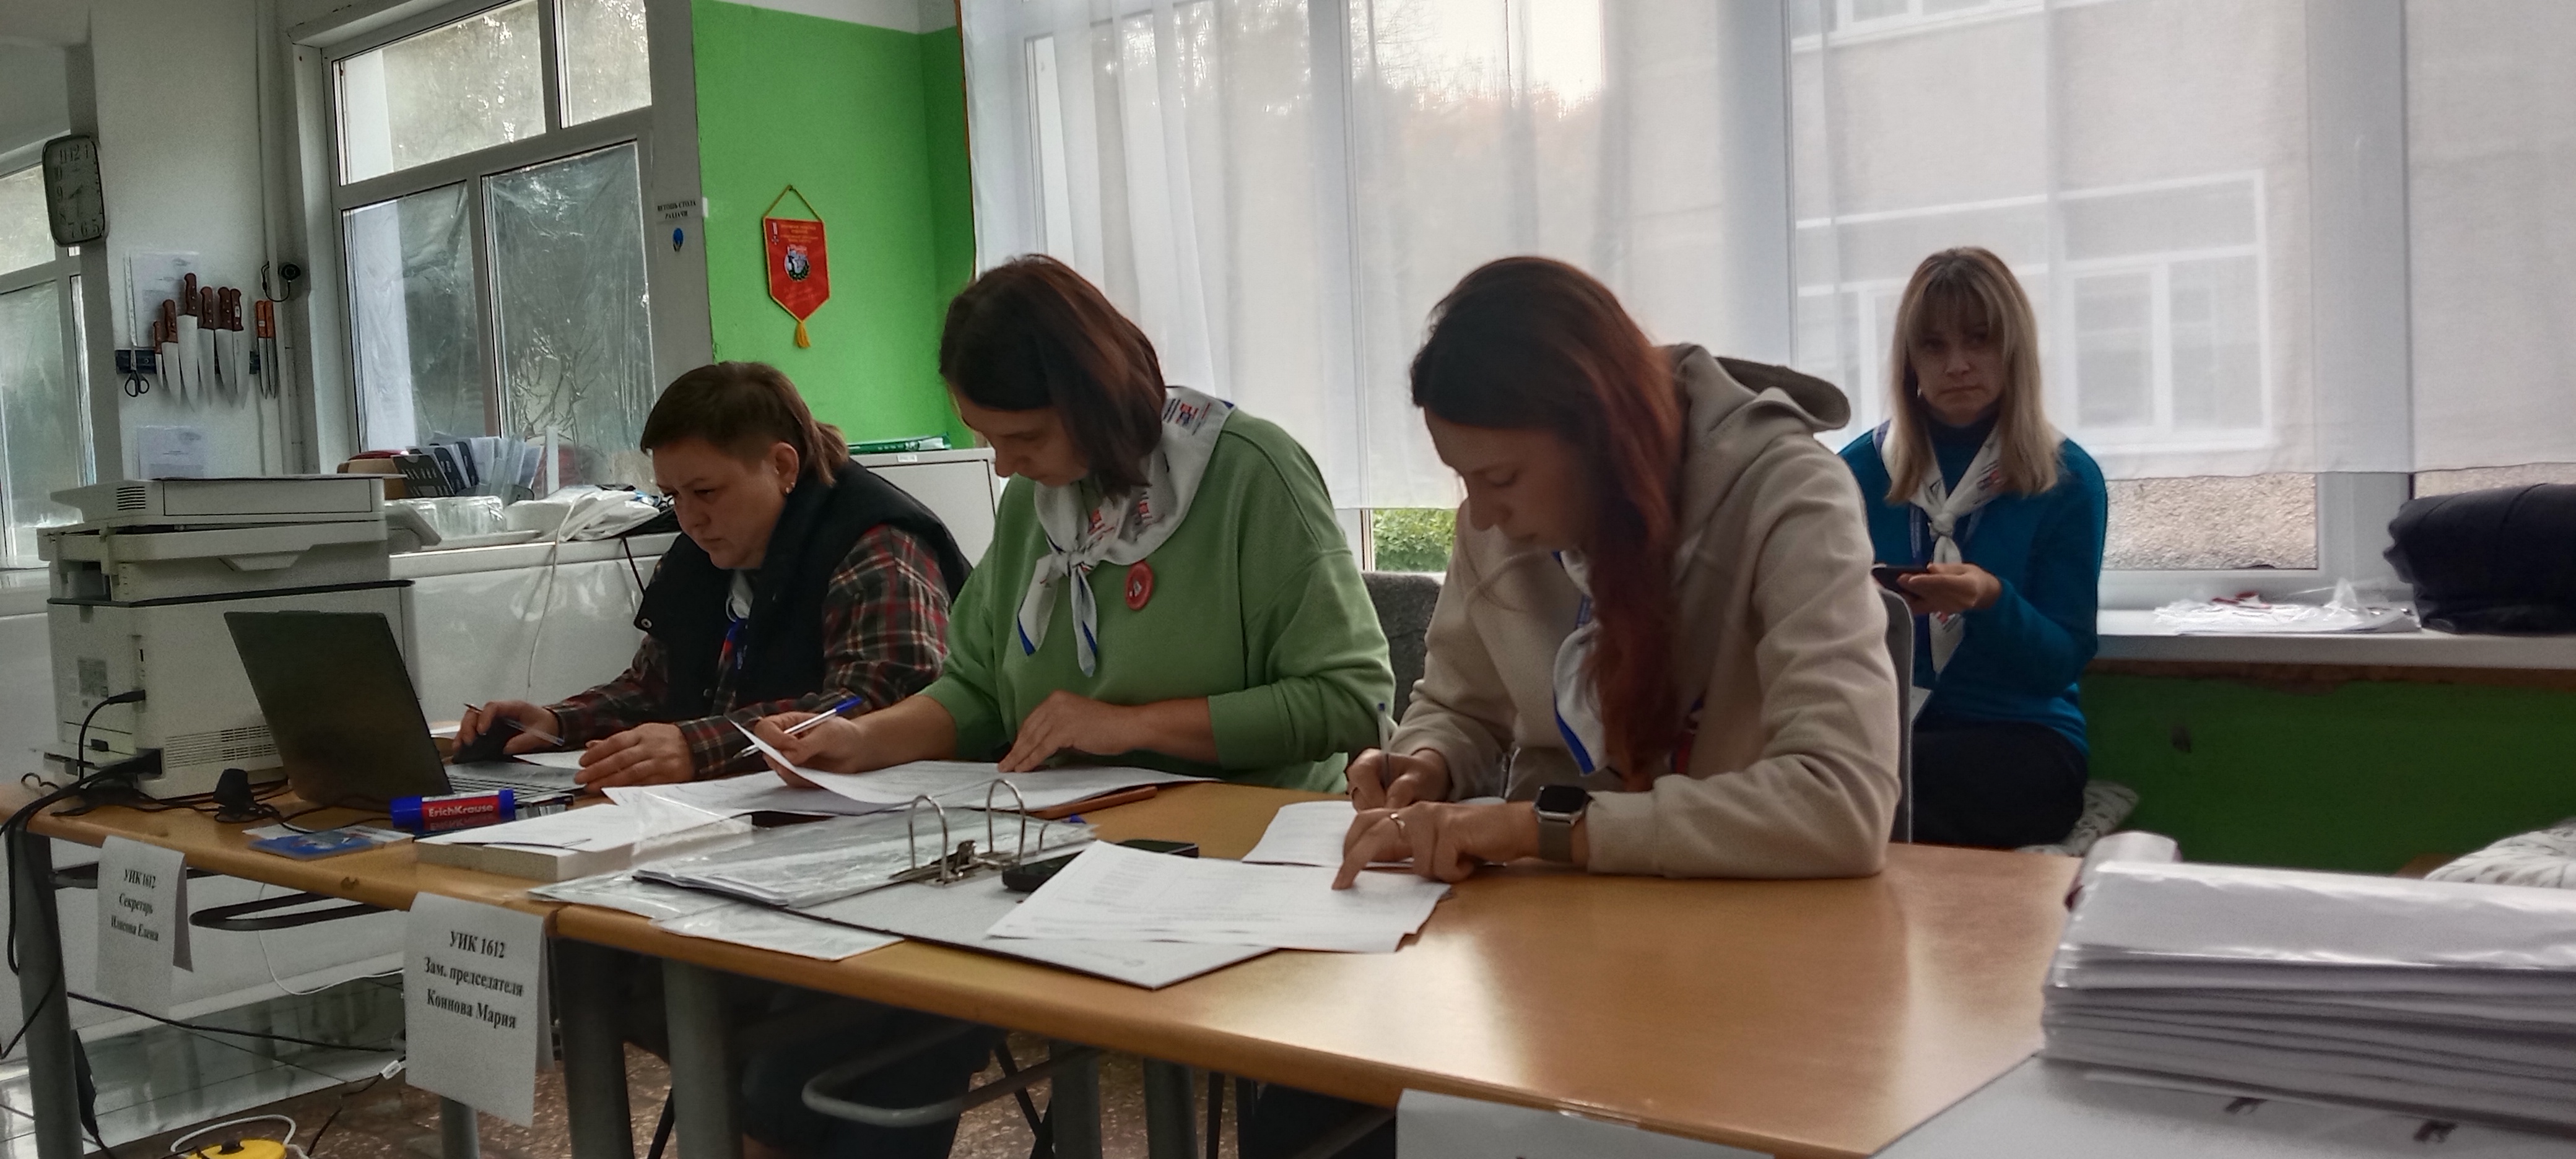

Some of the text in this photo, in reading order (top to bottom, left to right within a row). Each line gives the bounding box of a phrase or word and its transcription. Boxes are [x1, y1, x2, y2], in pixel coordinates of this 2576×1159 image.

[56, 186, 63, 203] 9
[68, 222, 75, 239] 7
[80, 220, 88, 237] 6
[429, 804, 494, 818] ErichKrause
[124, 869, 157, 889] УИК 1612
[119, 893, 154, 916] Секретарь
[137, 923, 159, 942] Елена
[450, 931, 506, 959] УИК 1612
[424, 957, 524, 997] Зам. председателя
[427, 988, 516, 1029] Коннова Мария
